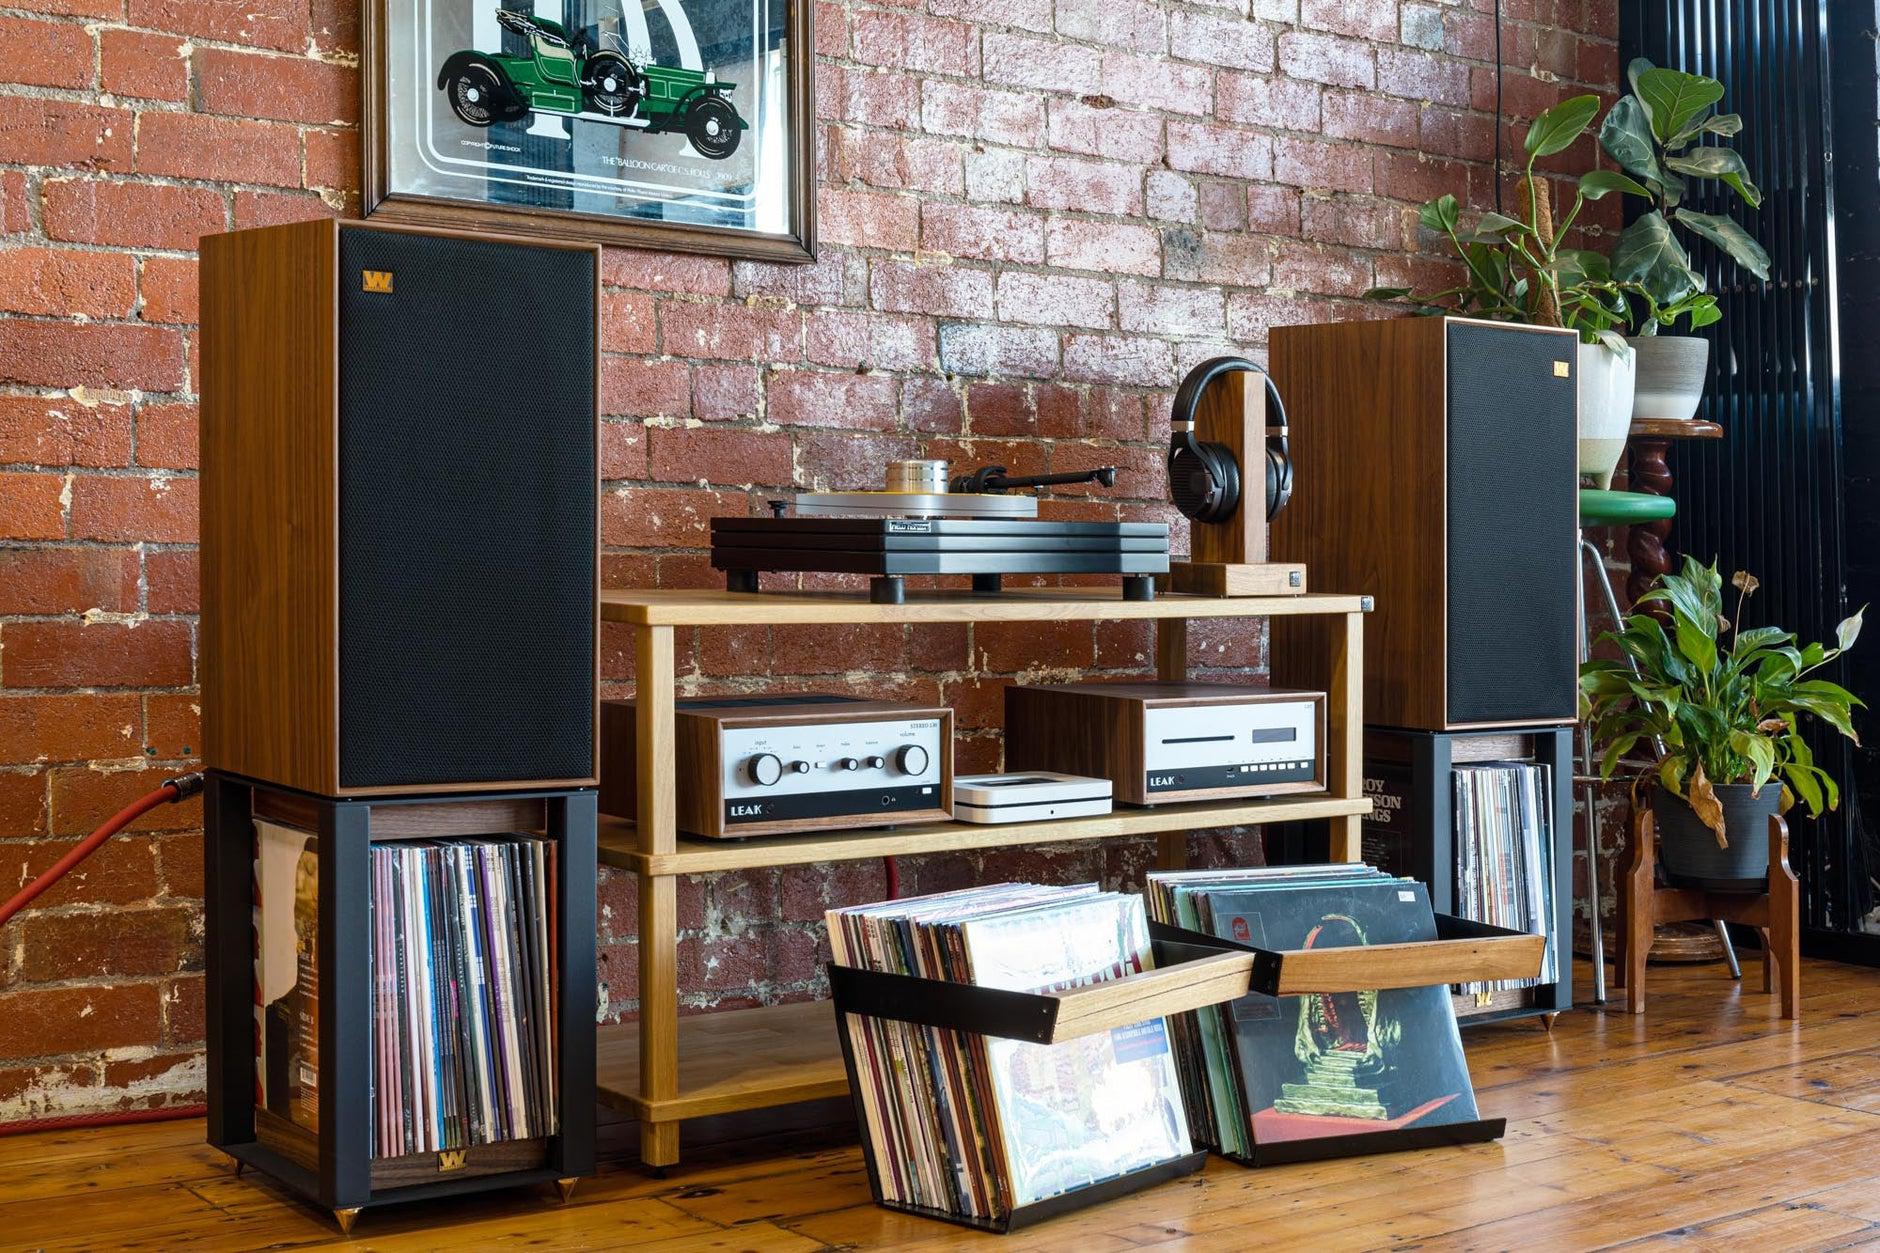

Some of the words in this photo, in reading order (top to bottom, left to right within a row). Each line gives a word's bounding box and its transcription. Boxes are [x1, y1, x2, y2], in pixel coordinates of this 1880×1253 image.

[602, 156, 615, 165] THE
[1150, 776, 1174, 786] LEAK
[731, 804, 762, 816] LEAK
